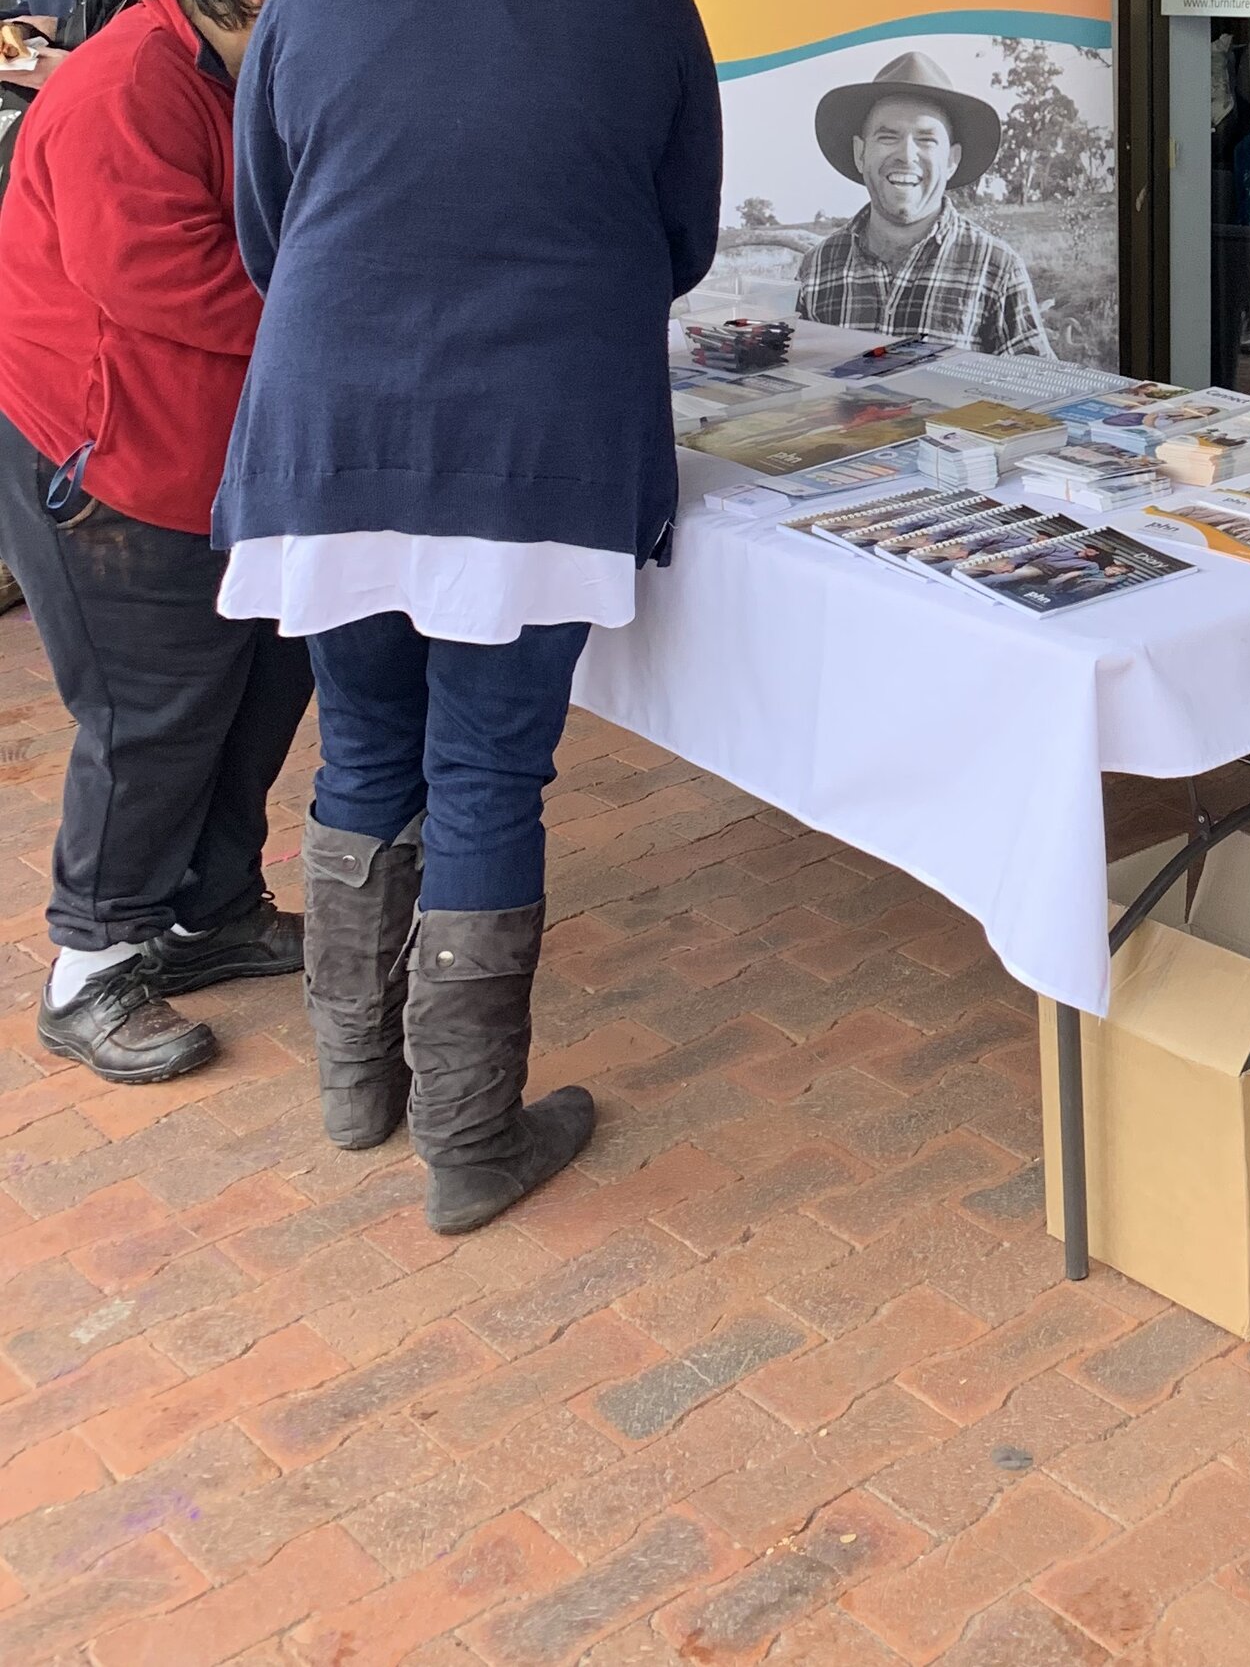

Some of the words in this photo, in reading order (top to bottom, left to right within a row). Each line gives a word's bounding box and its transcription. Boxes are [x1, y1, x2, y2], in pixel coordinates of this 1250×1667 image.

[766, 451, 803, 464] phn
[1144, 521, 1180, 532] phn
[1133, 552, 1170, 569] Diary
[1023, 590, 1051, 605] phn
